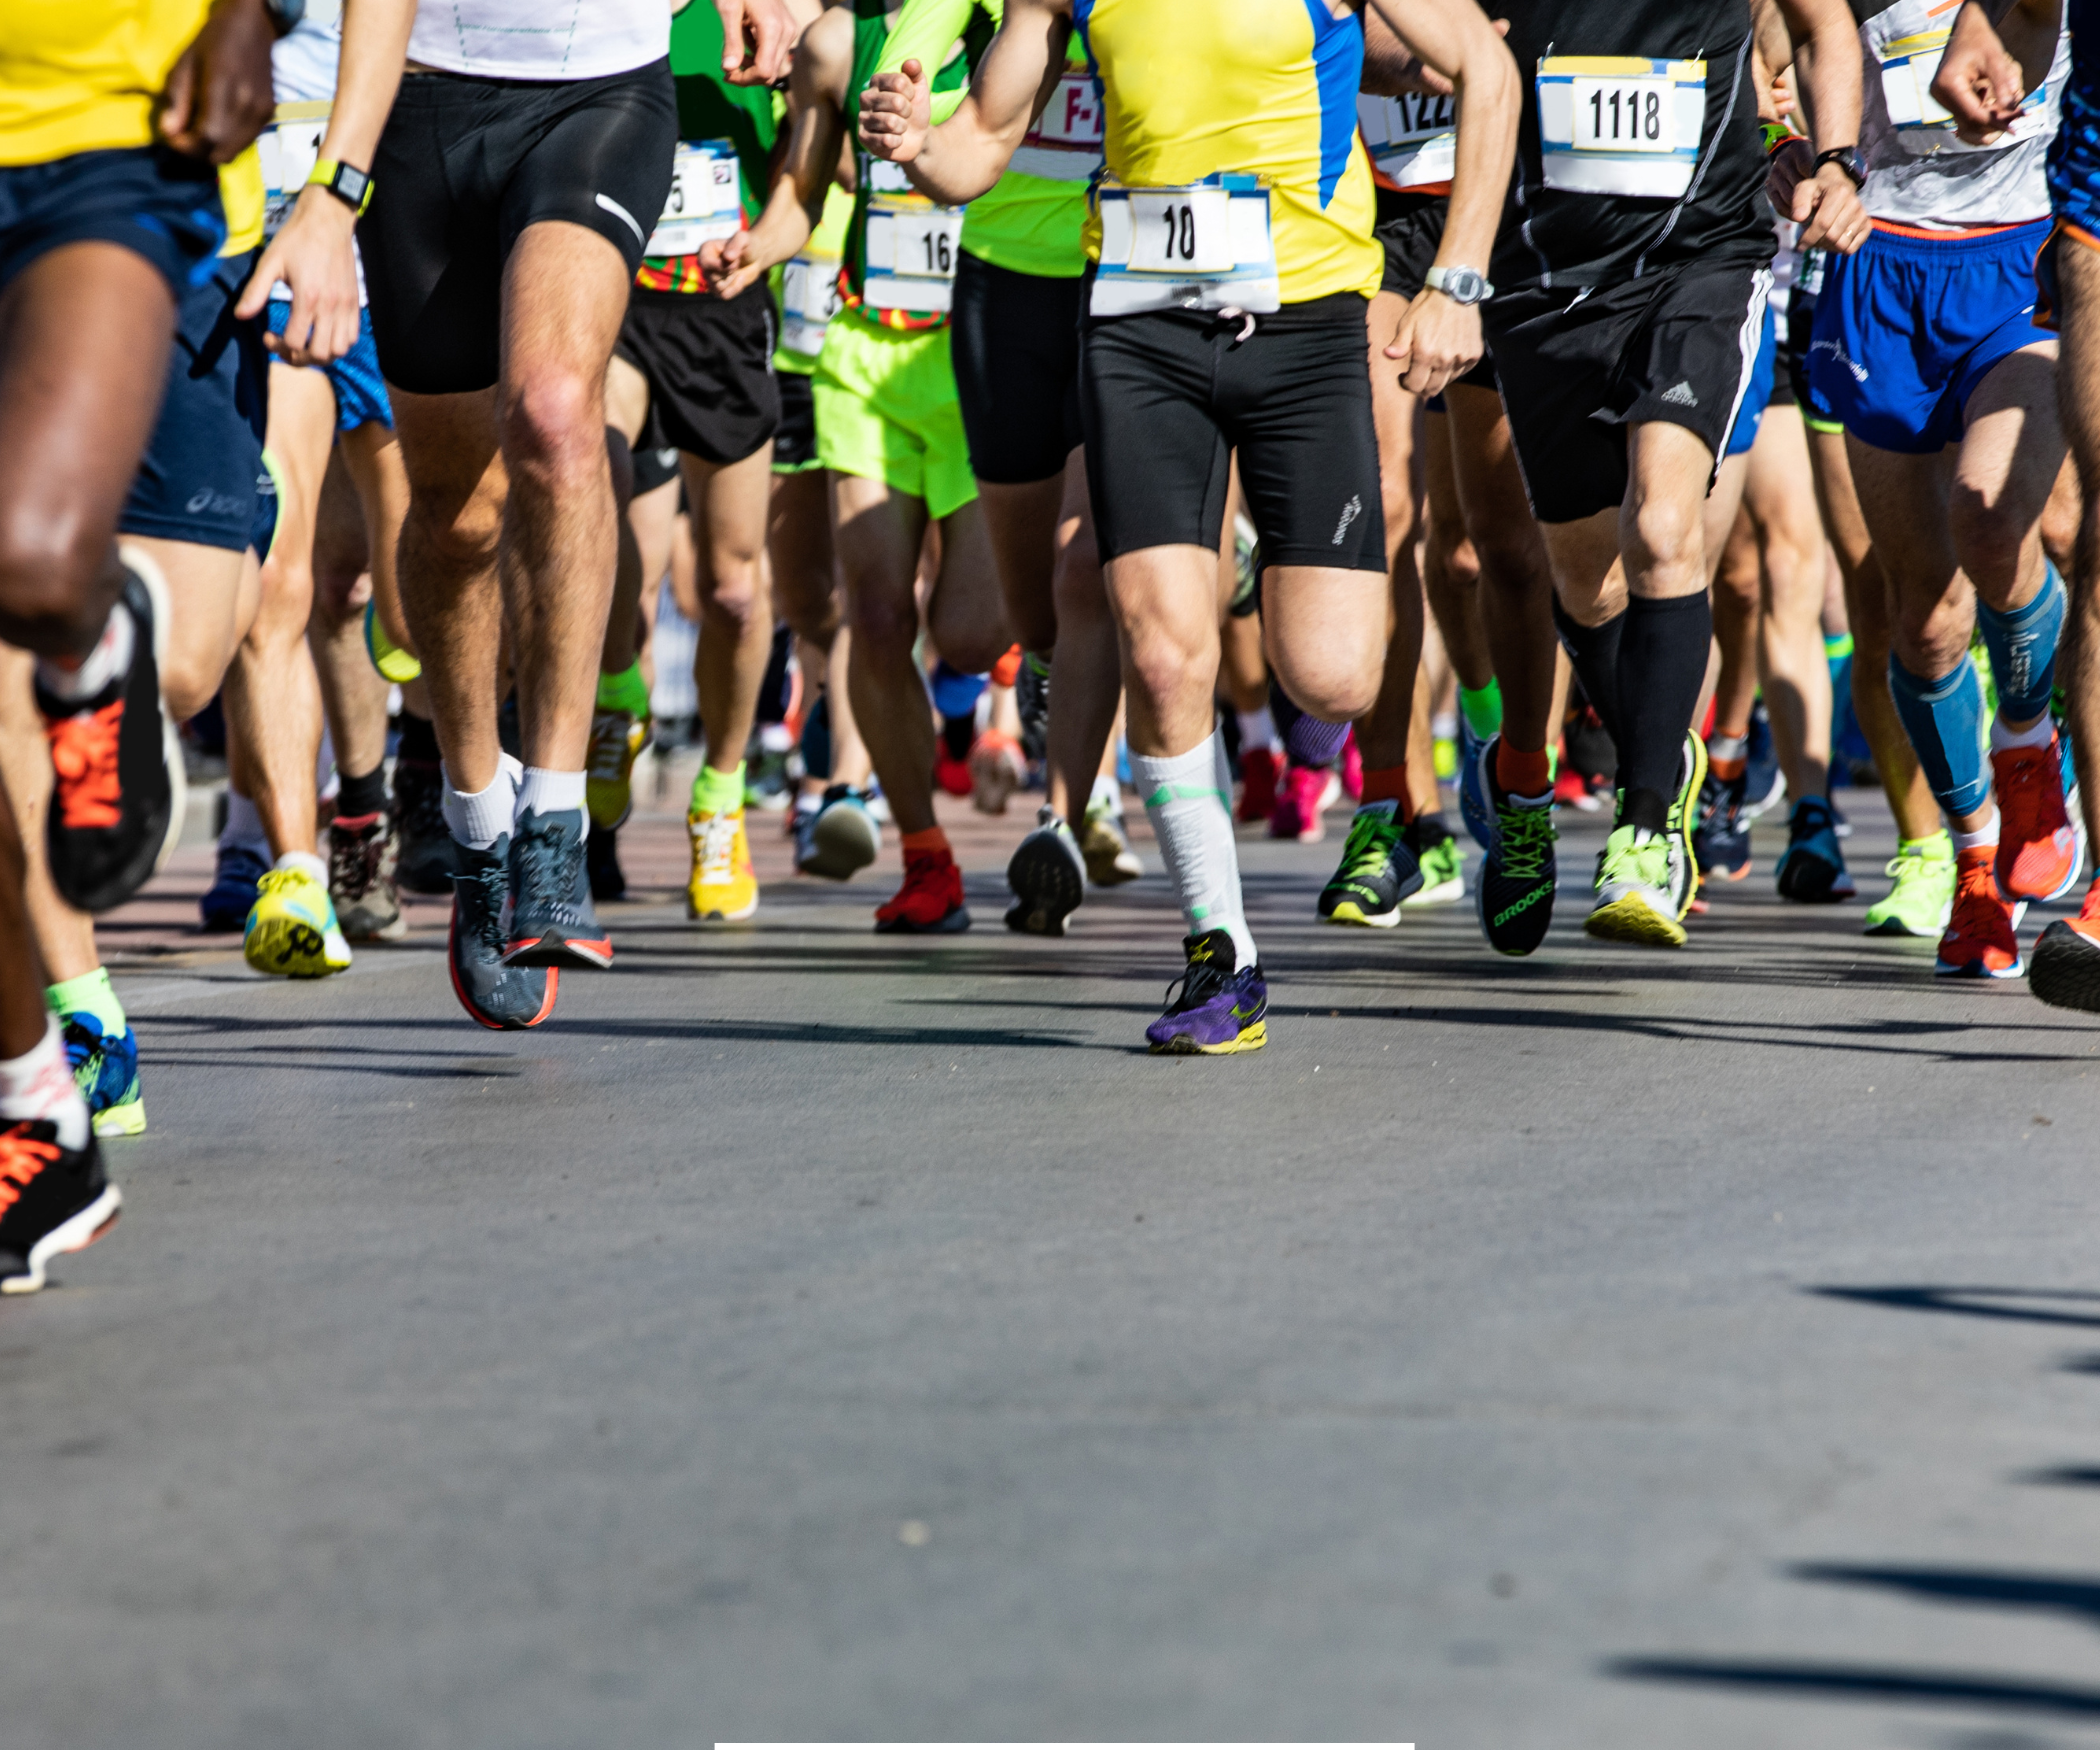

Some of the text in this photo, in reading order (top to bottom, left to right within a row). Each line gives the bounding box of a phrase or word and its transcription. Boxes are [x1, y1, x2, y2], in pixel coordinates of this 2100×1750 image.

[1394, 91, 1457, 134] 122
[1589, 88, 1660, 140] 1118
[923, 230, 951, 273] 16
[1162, 203, 1195, 261] 10
[1493, 879, 1553, 927] BROOKS
